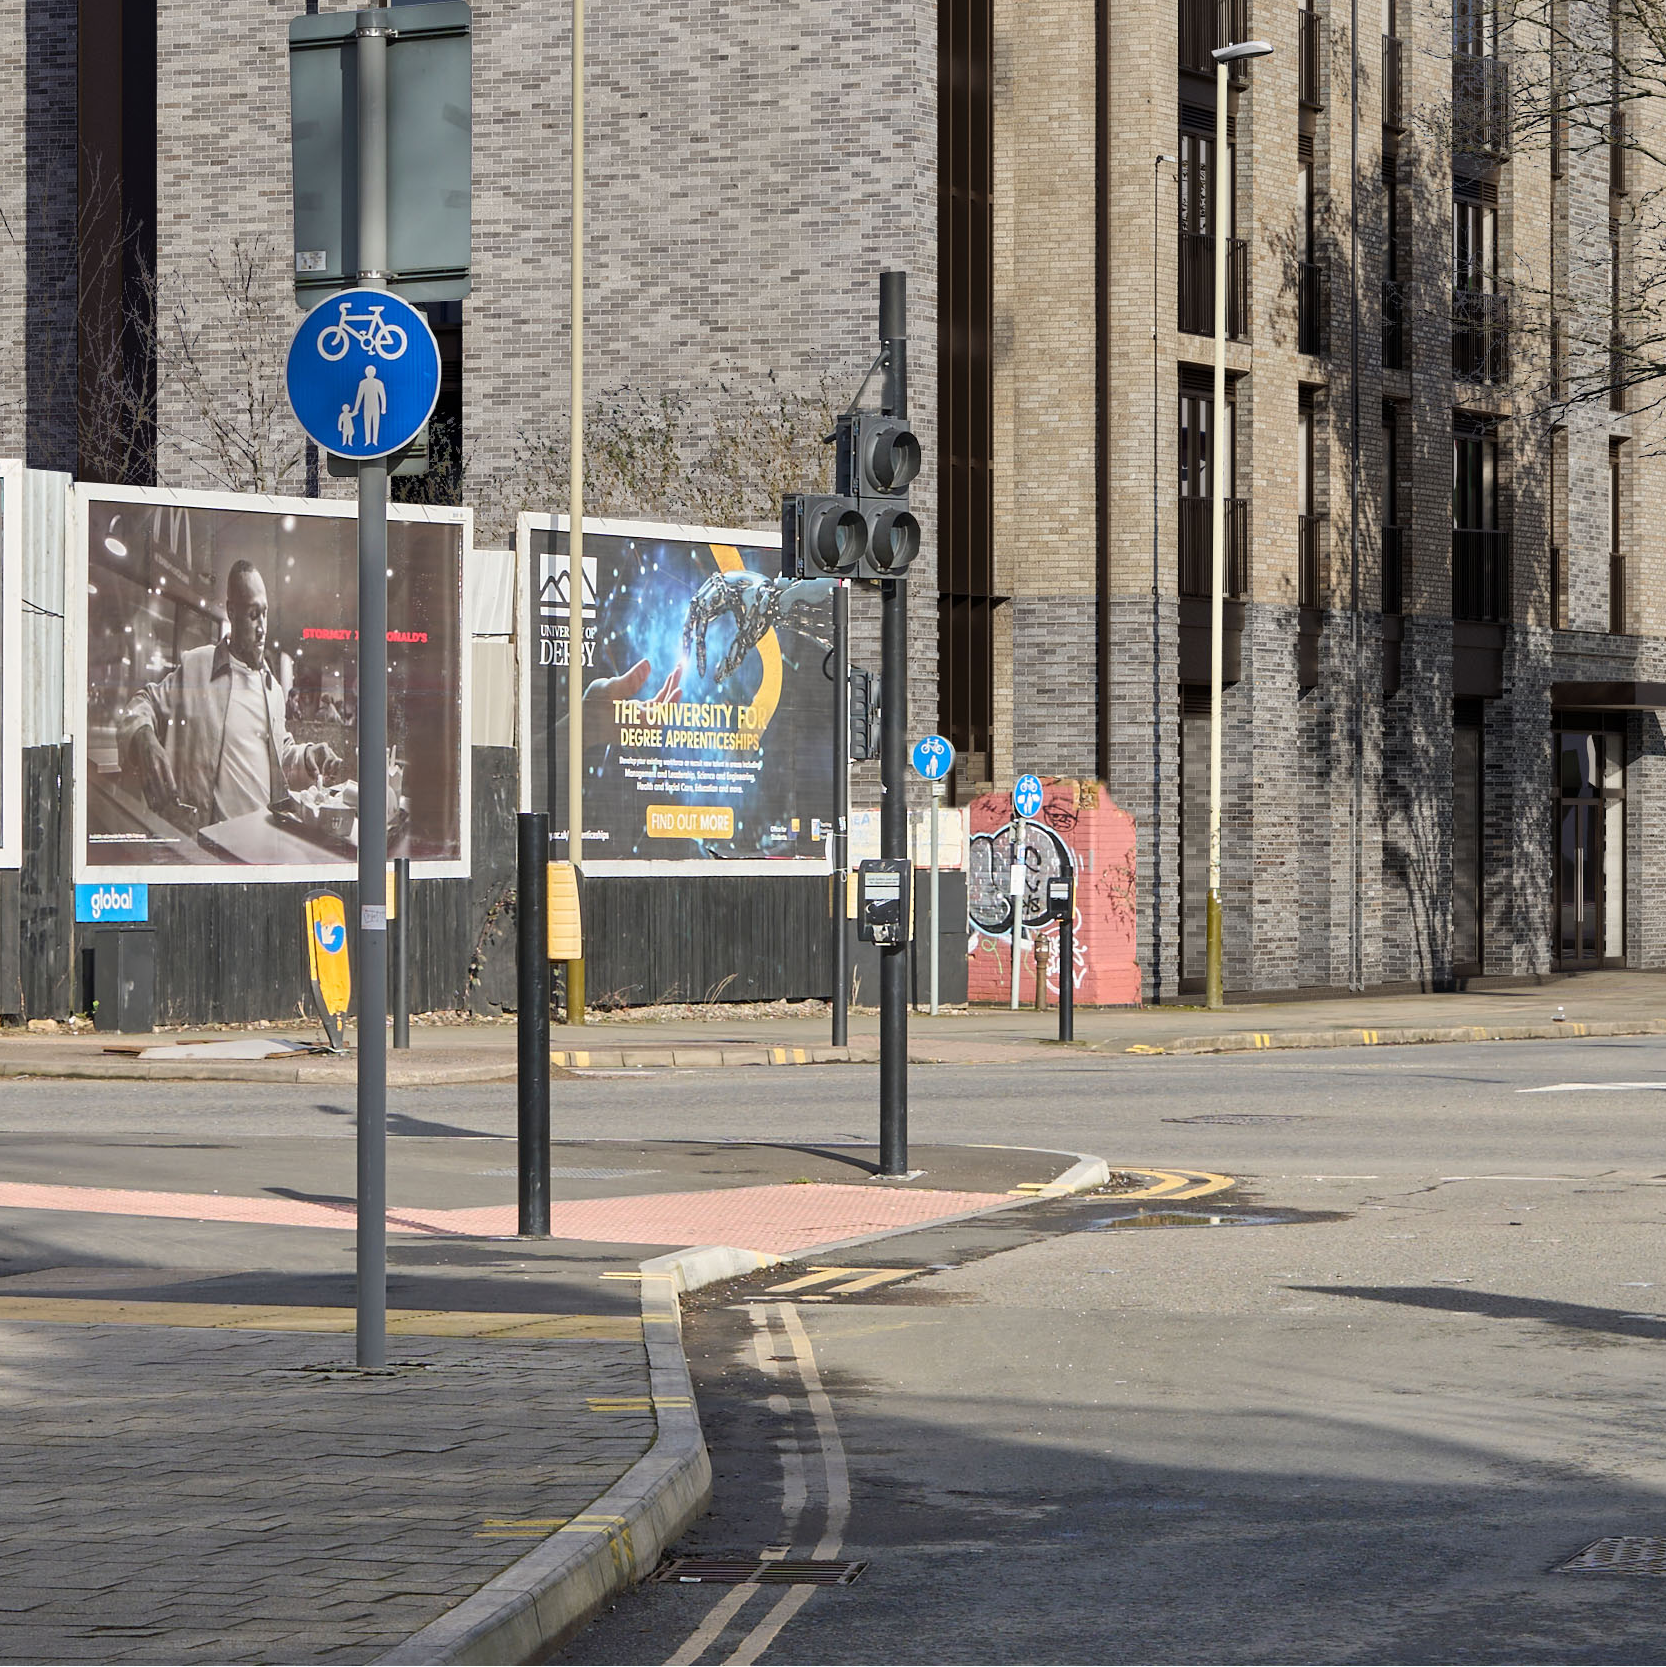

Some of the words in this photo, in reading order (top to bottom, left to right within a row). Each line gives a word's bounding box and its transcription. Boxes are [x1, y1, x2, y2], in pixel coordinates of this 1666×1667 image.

[302, 628, 352, 640] STORMZY
[386, 631, 428, 643] ONALD'S
[540, 624, 584, 638] UNIVER
[585, 626, 597, 639] OF
[612, 699, 641, 725] THE
[645, 702, 733, 728] UNIVERSITY
[737, 706, 767, 730] FOR
[620, 728, 662, 747] DEGREE
[665, 729, 760, 751] APPRENTICESHIPS
[651, 813, 674, 829] FIND
[677, 814, 697, 830] OUT
[700, 815, 729, 831] MORE
[90, 886, 133, 919] global
